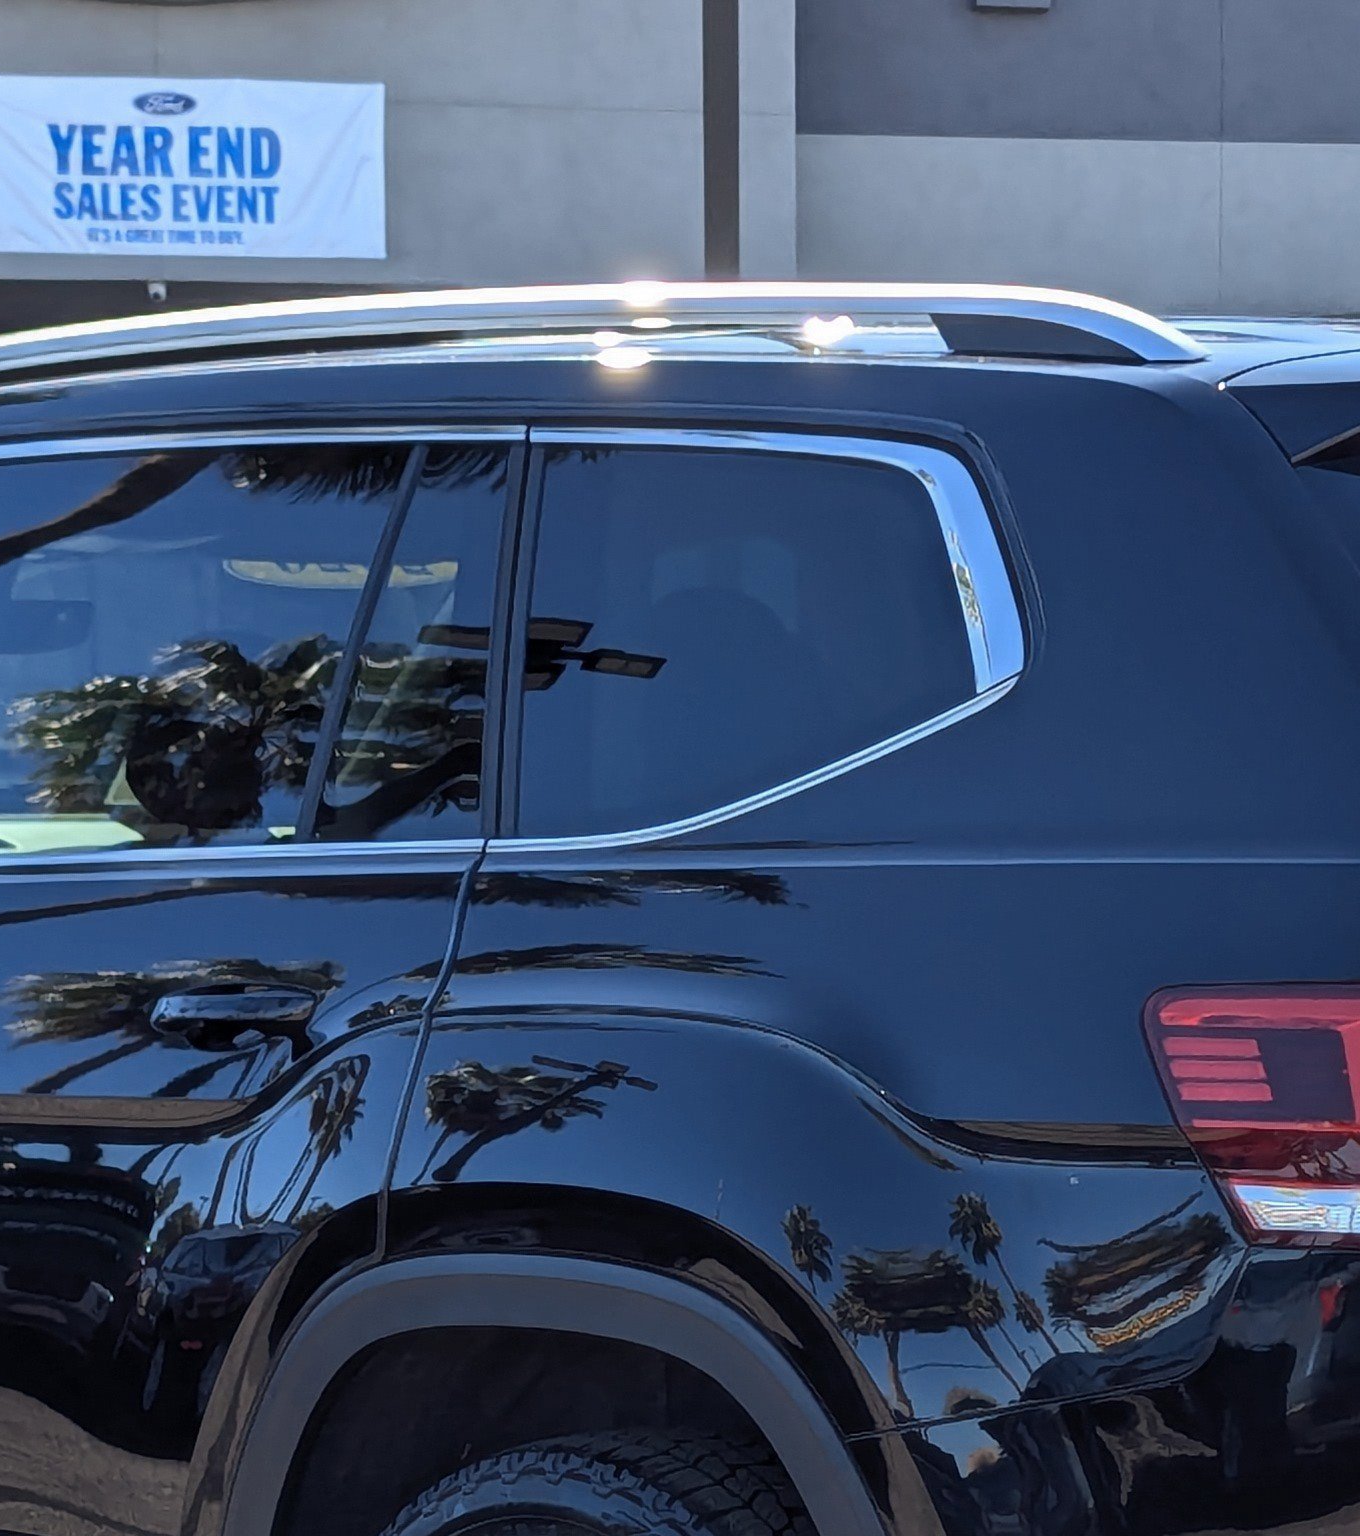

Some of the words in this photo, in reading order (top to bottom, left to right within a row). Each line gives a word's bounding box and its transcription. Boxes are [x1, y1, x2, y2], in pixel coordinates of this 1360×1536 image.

[140, 94, 189, 114] Ford
[48, 124, 173, 177] YEAR
[188, 126, 281, 178] END
[54, 182, 161, 221] SALES
[172, 184, 279, 223] EVENT
